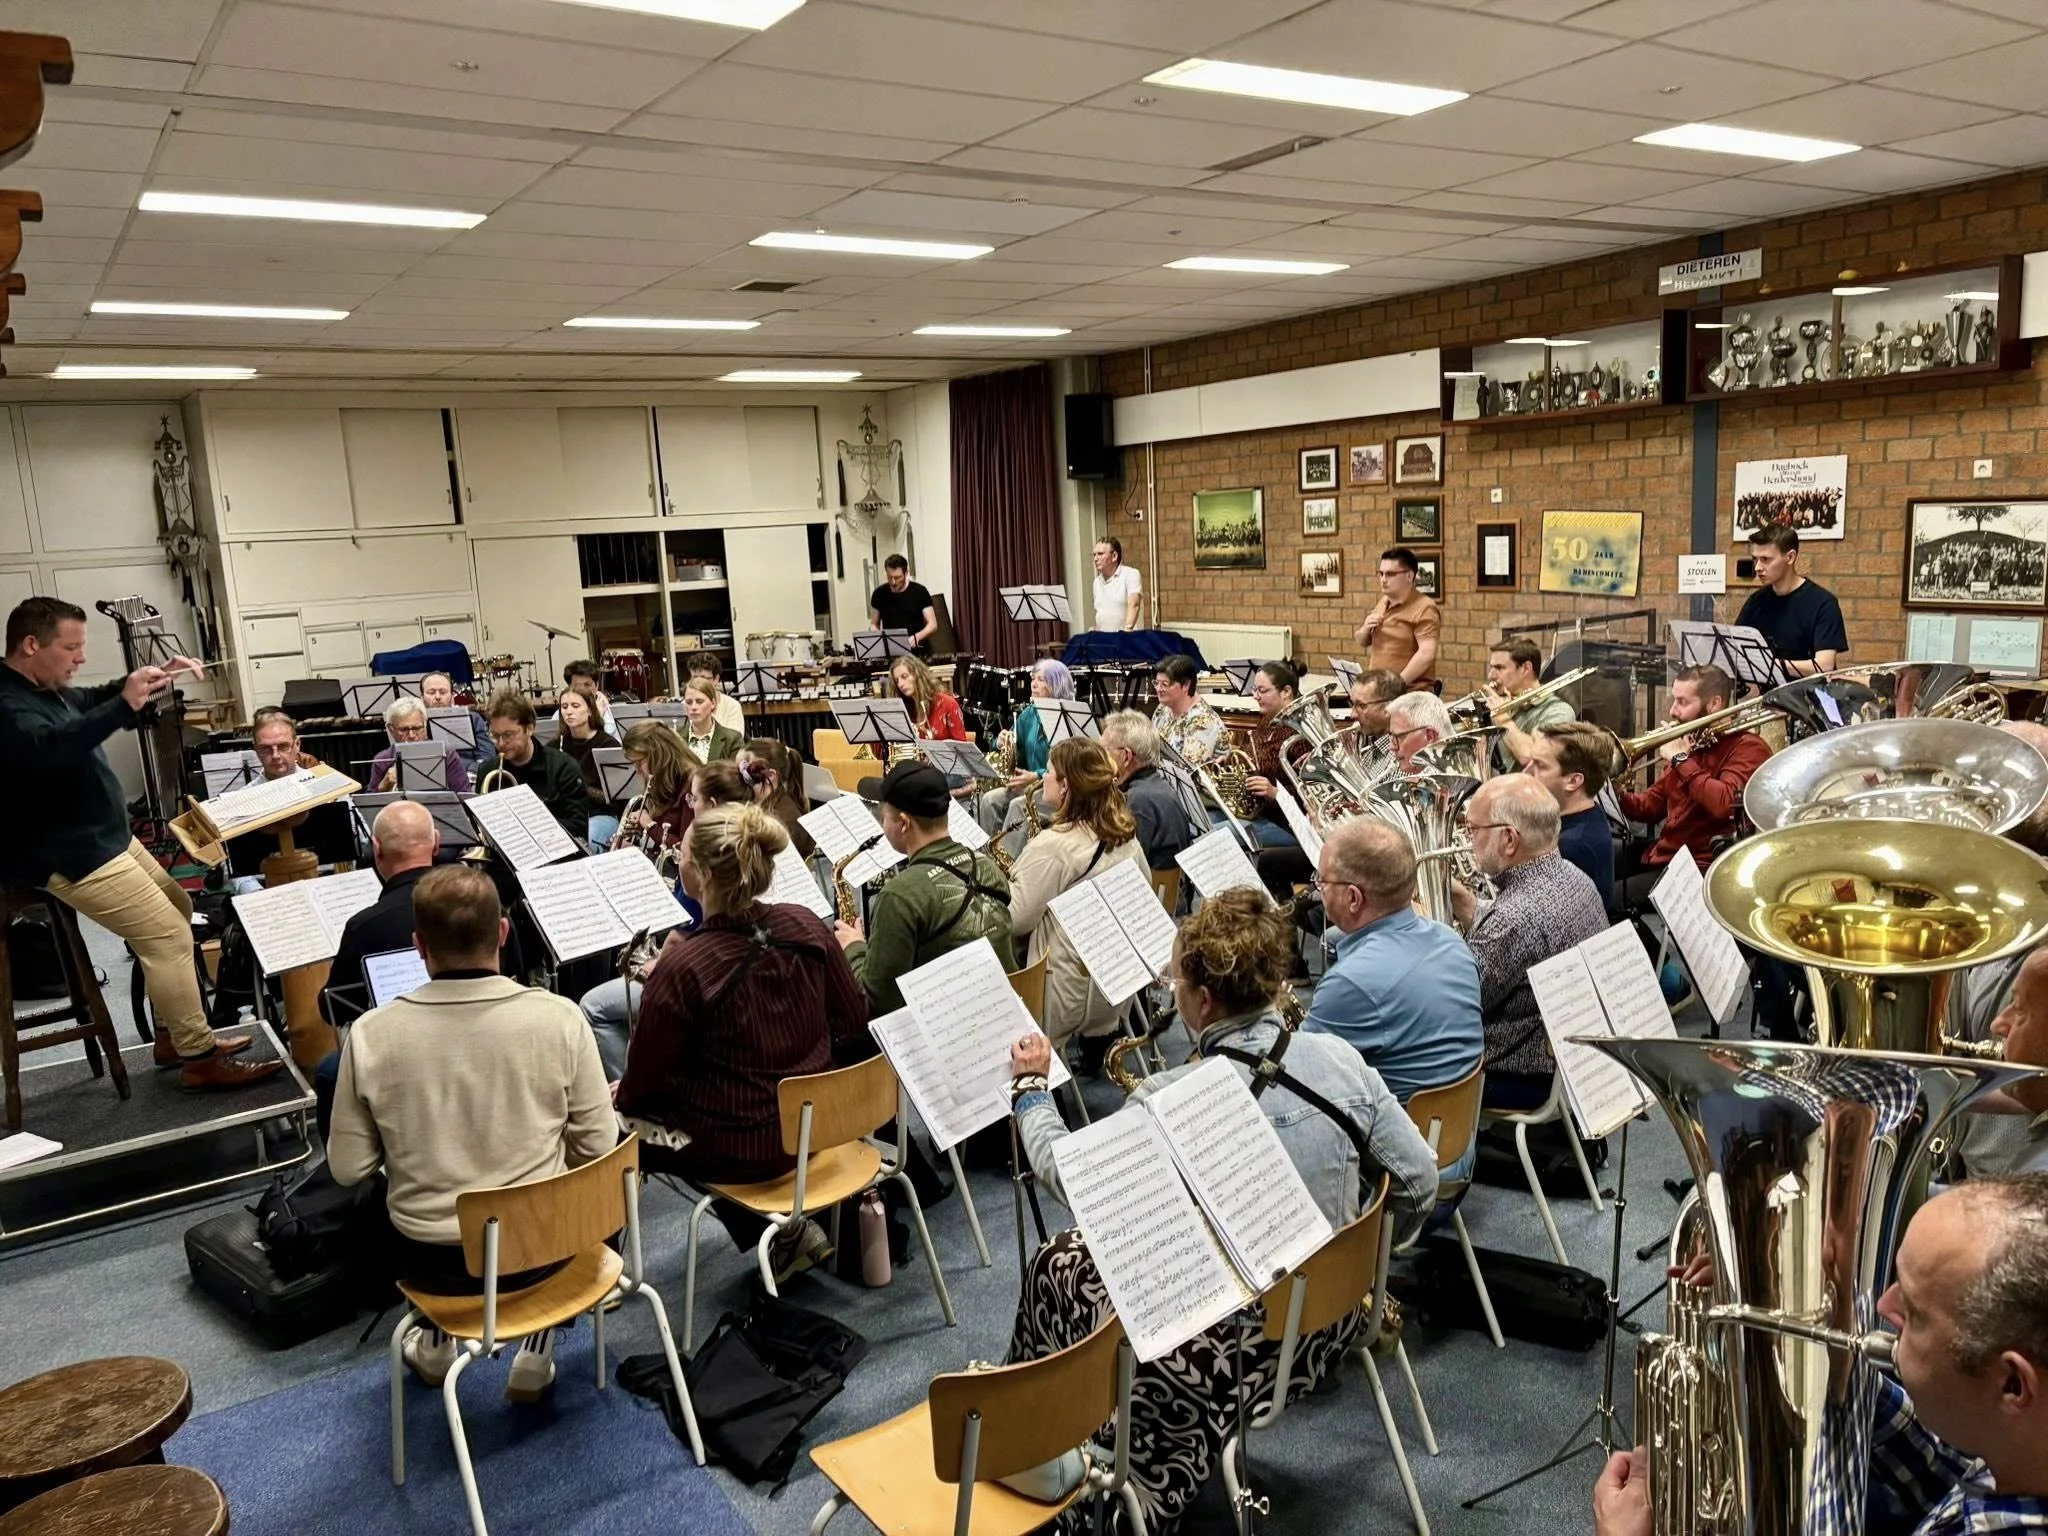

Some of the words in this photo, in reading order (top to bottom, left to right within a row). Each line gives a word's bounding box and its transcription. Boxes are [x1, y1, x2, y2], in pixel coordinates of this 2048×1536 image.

[1677, 254, 1740, 275] DIETEREN
[1552, 536, 1588, 561] 50
[1687, 567, 1718, 576] STOELEN
[428, 627, 438, 636] 13
[311, 637, 318, 645] 5
[255, 661, 262, 669] 2
